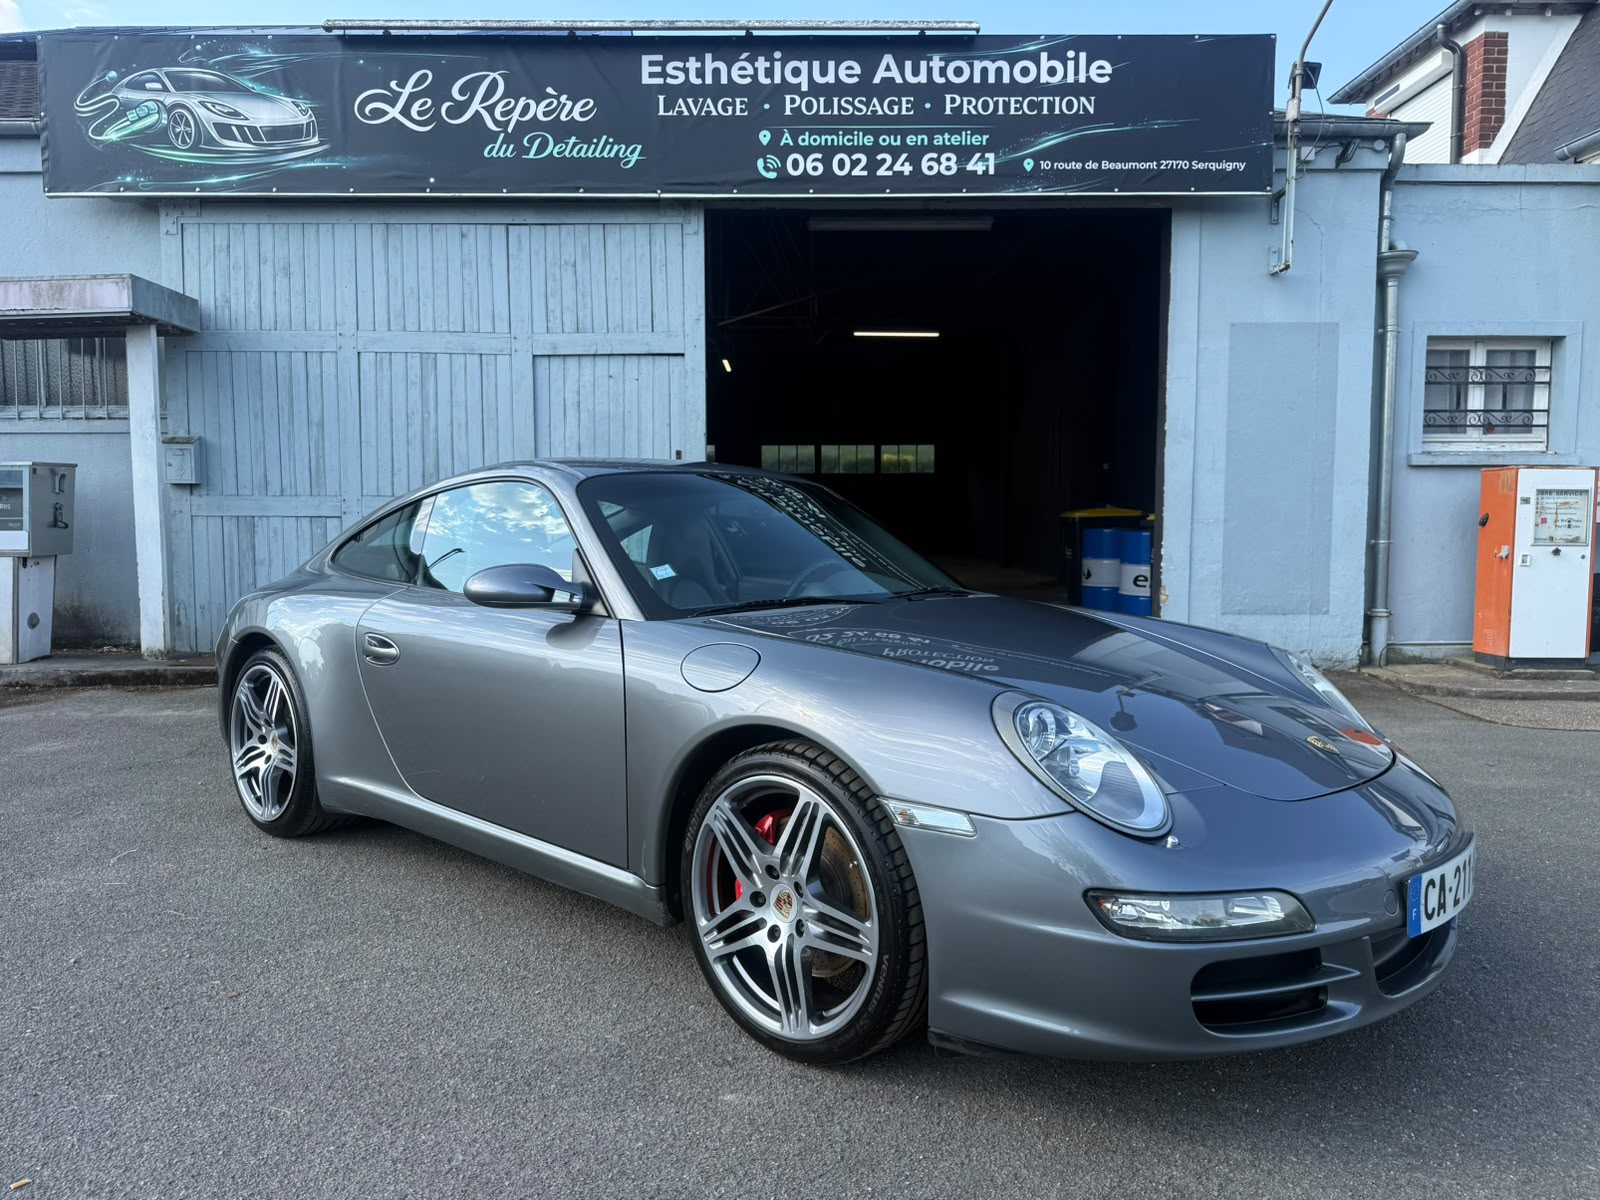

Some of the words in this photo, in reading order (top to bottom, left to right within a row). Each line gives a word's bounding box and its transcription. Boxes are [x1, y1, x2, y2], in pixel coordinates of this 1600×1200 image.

[641, 51, 862, 92] Esthétique
[872, 50, 1113, 85] Automobile
[354, 69, 437, 133] Le
[440, 70, 598, 134] Repère
[657, 95, 748, 117] LAVAGE
[784, 94, 914, 116] POLISSAGE
[944, 94, 1096, 116] PROTECTION
[780, 129, 794, 147] À
[798, 130, 874, 147] domicile
[878, 134, 901, 147] ou
[906, 134, 928, 147] en
[932, 130, 990, 146] atelier
[483, 132, 517, 159] du
[521, 131, 648, 170] Detailing
[786, 153, 825, 177] 06
[832, 153, 869, 176] 02
[876, 153, 914, 176] 24
[921, 153, 958, 176] 68
[965, 153, 995, 176] 41
[1040, 160, 1052, 171] 10
[1053, 160, 1083, 171] route
[1085, 160, 1099, 171] de
[1101, 160, 1158, 171] Beaumont
[1160, 160, 1190, 171] 27170
[1191, 160, 1247, 172] Serquigny
[1412, 908, 1417, 920] F
